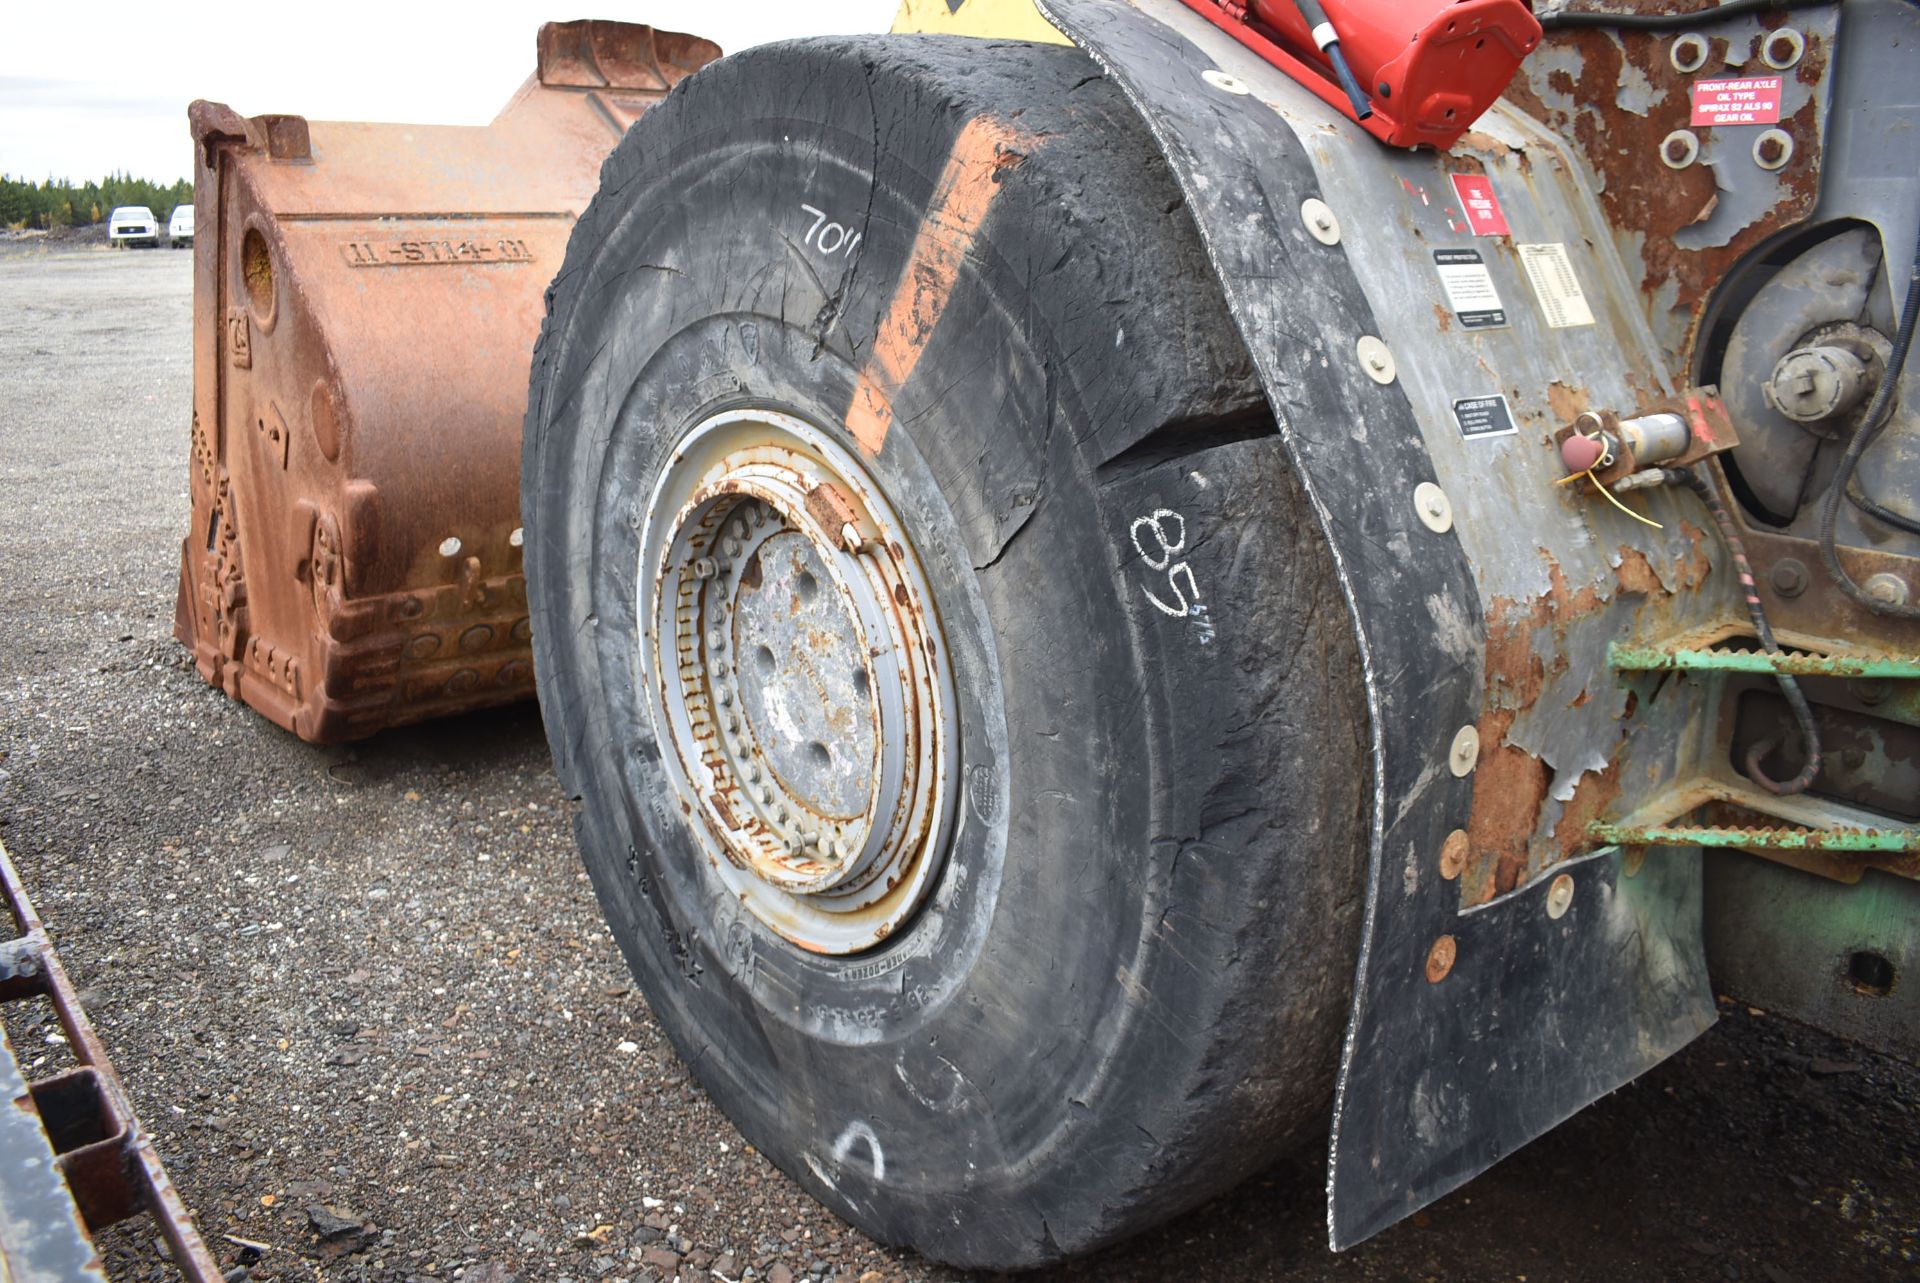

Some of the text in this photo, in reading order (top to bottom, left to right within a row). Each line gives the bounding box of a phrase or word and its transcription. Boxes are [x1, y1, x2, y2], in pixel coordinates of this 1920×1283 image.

[1697, 80, 1777, 92] FRONT-REAR AXLE
[1716, 92, 1756, 101] OIL TYPE
[1698, 103, 1730, 113] SPIRAX
[1731, 103, 1743, 112] S2
[1743, 102, 1761, 111] ALS
[1713, 113, 1755, 123] GEAR OIL
